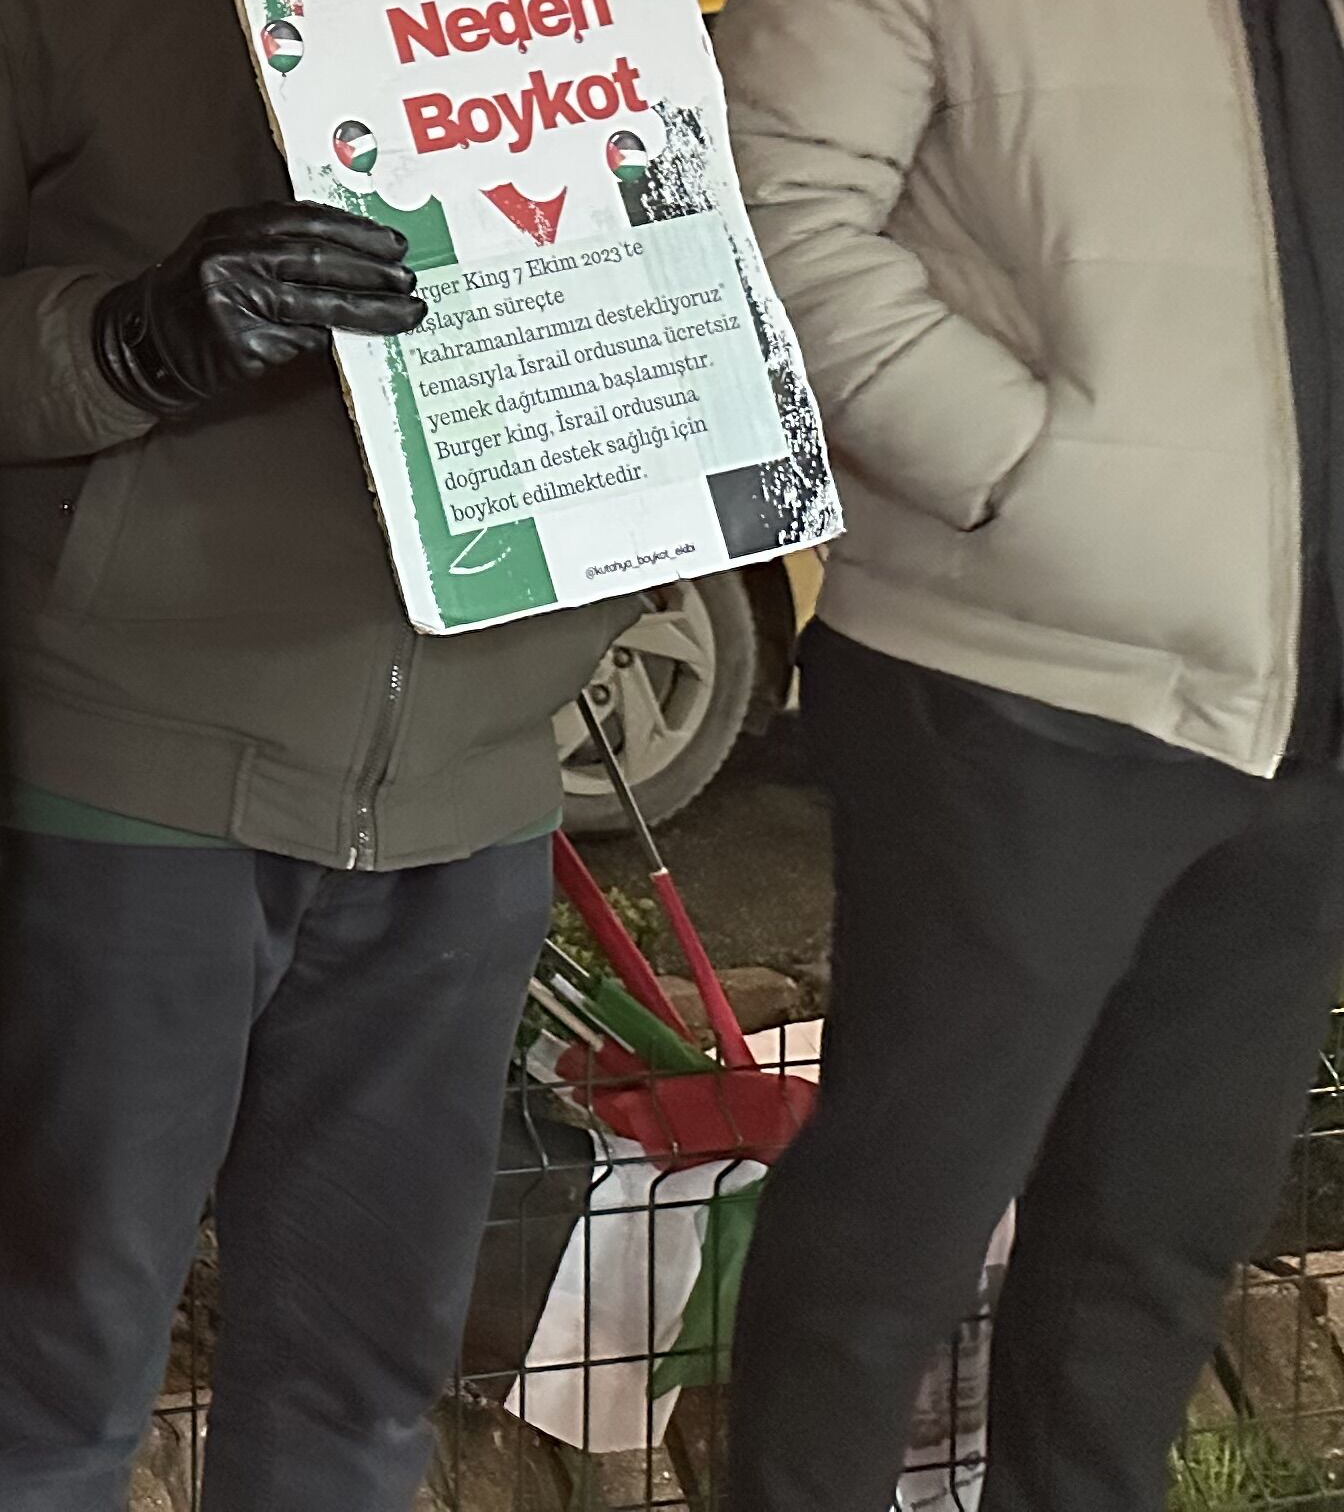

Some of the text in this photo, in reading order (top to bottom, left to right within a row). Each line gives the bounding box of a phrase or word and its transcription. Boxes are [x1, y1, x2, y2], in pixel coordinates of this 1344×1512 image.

[402, 56, 650, 155] Boykot
[462, 268, 511, 292] King
[513, 267, 523, 286] 7
[525, 254, 580, 279] Ekim
[489, 289, 566, 317] süreçte
[418, 313, 741, 398] temasıyla İsrail ordusuna ücretsiz
[426, 353, 715, 434] yemek dağıtımına başlamıştır.
[434, 388, 701, 461] Burger king, İsrail ordusuna
[444, 414, 709, 491] doğrudan destek sağlığı için
[449, 463, 649, 523] boykot edilmektedir.
